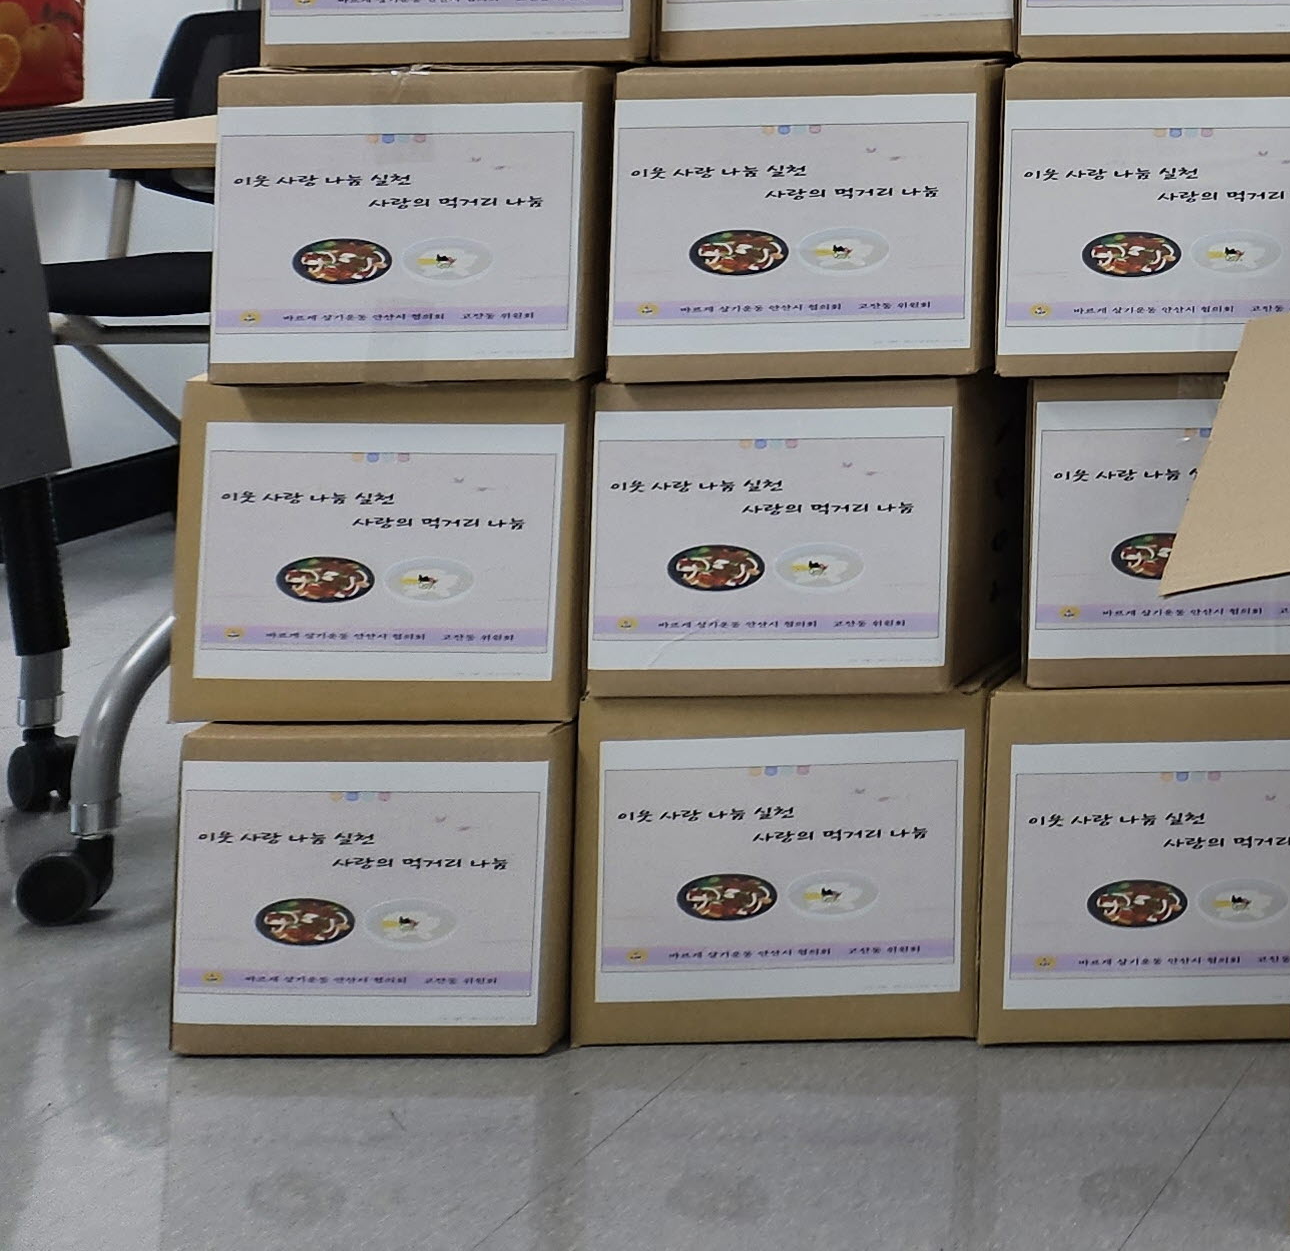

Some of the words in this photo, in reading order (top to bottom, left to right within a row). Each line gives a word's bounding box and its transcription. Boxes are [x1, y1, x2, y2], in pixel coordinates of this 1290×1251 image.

[234, 175, 270, 187] 이웃
[276, 175, 319, 187] 사랑
[325, 175, 362, 186] 나눔
[371, 173, 411, 186] 실천
[1024, 169, 1059, 181] 이웃
[1066, 169, 1107, 180] 사랑
[1114, 168, 1150, 180] 나눔
[1159, 167, 1198, 180] 실천
[369, 197, 429, 209] 사랑의
[439, 196, 497, 208] 먹거리
[506, 196, 543, 207] 나눔
[1157, 191, 1217, 203] 사랑의
[1227, 190, 1284, 202] 먹거리
[611, 480, 645, 493] 이웃
[651, 481, 692, 493] 사랑
[699, 480, 735, 492] 나눔
[744, 479, 783, 492] 실천
[742, 503, 802, 515] 사랑의
[811, 502, 868, 515] 먹거리
[877, 502, 914, 514] 나눔
[617, 810, 653, 823] 이웃
[660, 809, 702, 822] 사랑
[708, 808, 745, 821] 나눔
[754, 806, 794, 820] 실천
[198, 831, 234, 843] 이웃
[240, 832, 282, 844] 사랑
[288, 832, 326, 845] 나눔
[334, 832, 374, 845] 실천
[753, 830, 814, 844] 사랑의
[823, 828, 882, 841] 먹거리
[890, 827, 928, 839] 나눔
[332, 857, 393, 869] 사랑의
[402, 857, 461, 870] 먹거리
[470, 858, 508, 870] 나눔
